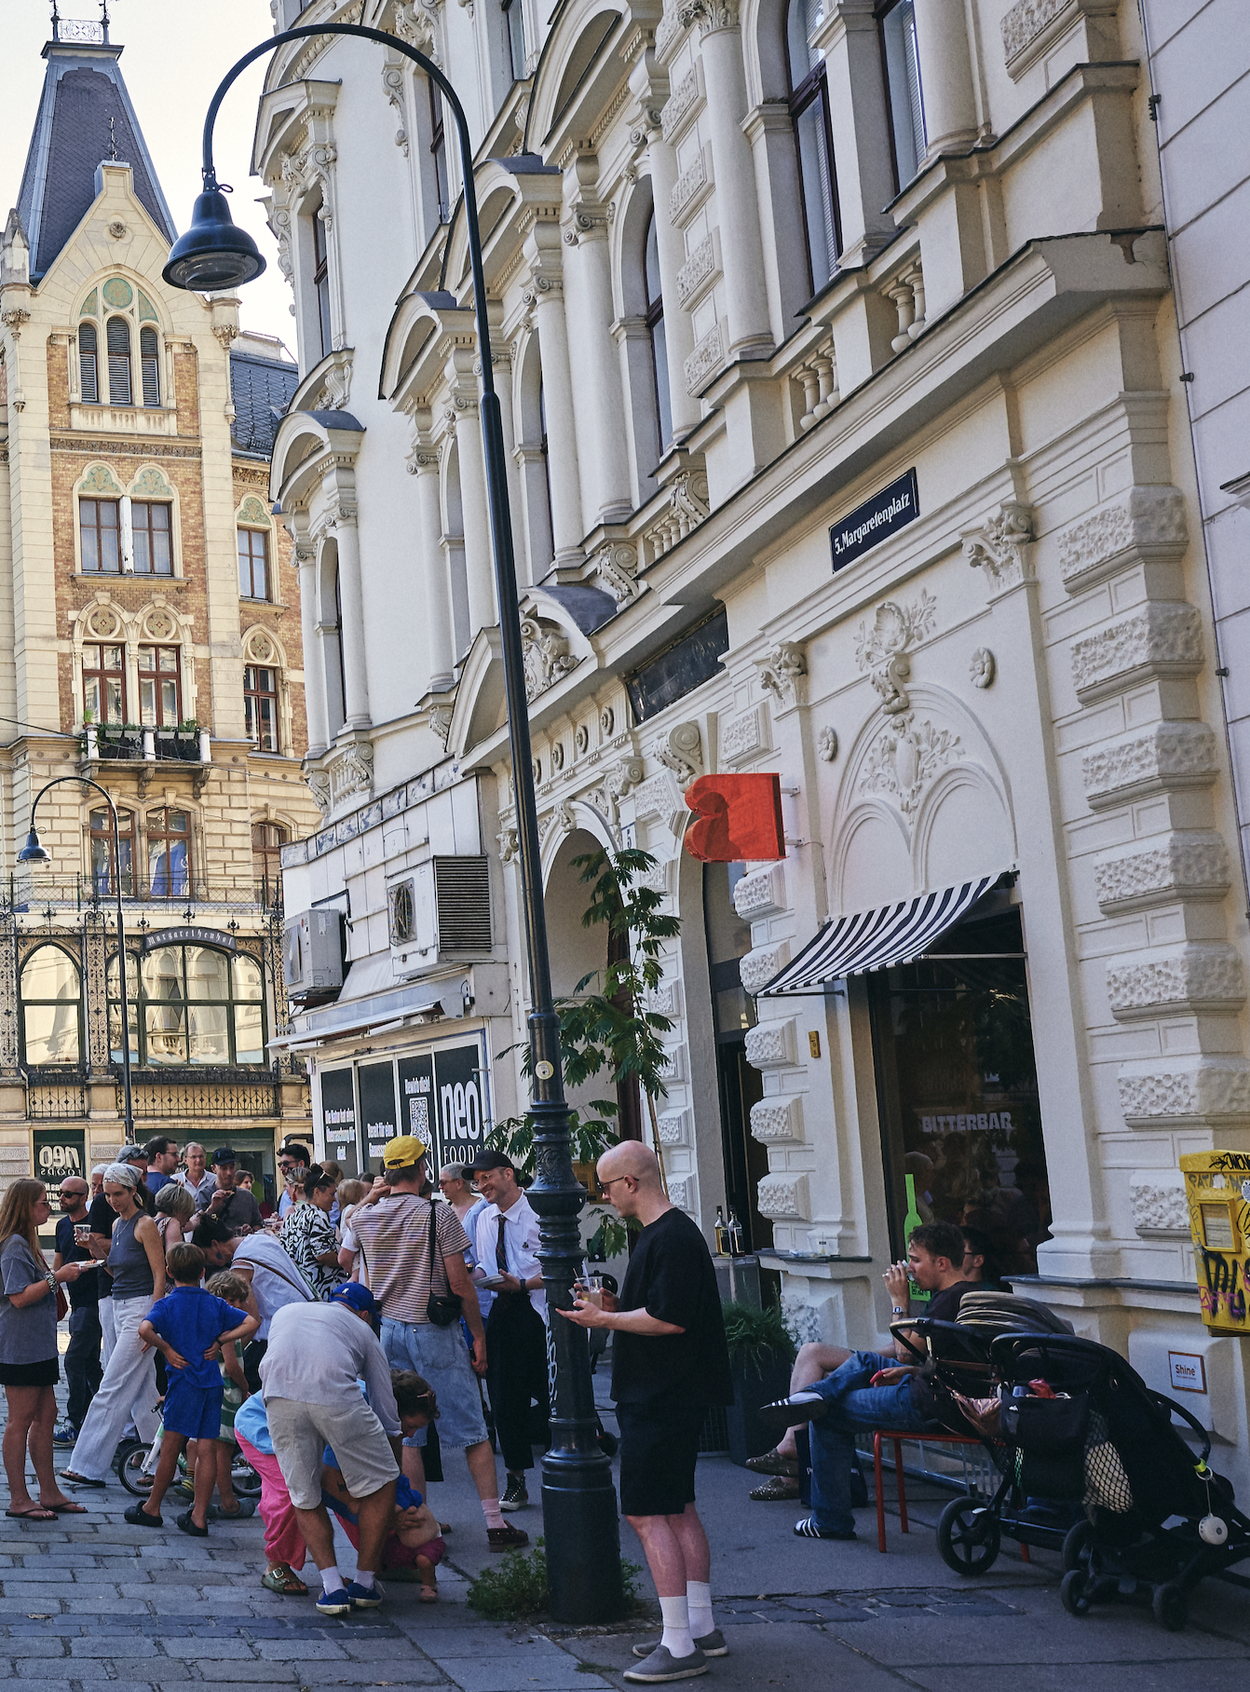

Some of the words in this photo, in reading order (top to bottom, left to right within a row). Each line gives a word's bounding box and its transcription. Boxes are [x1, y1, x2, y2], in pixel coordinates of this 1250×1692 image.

[842, 492, 911, 549] Margaretenplatz
[440, 1080, 481, 1140] neo
[921, 1111, 1012, 1133] BITTERBAR
[1175, 1364, 1196, 1377] Shine
